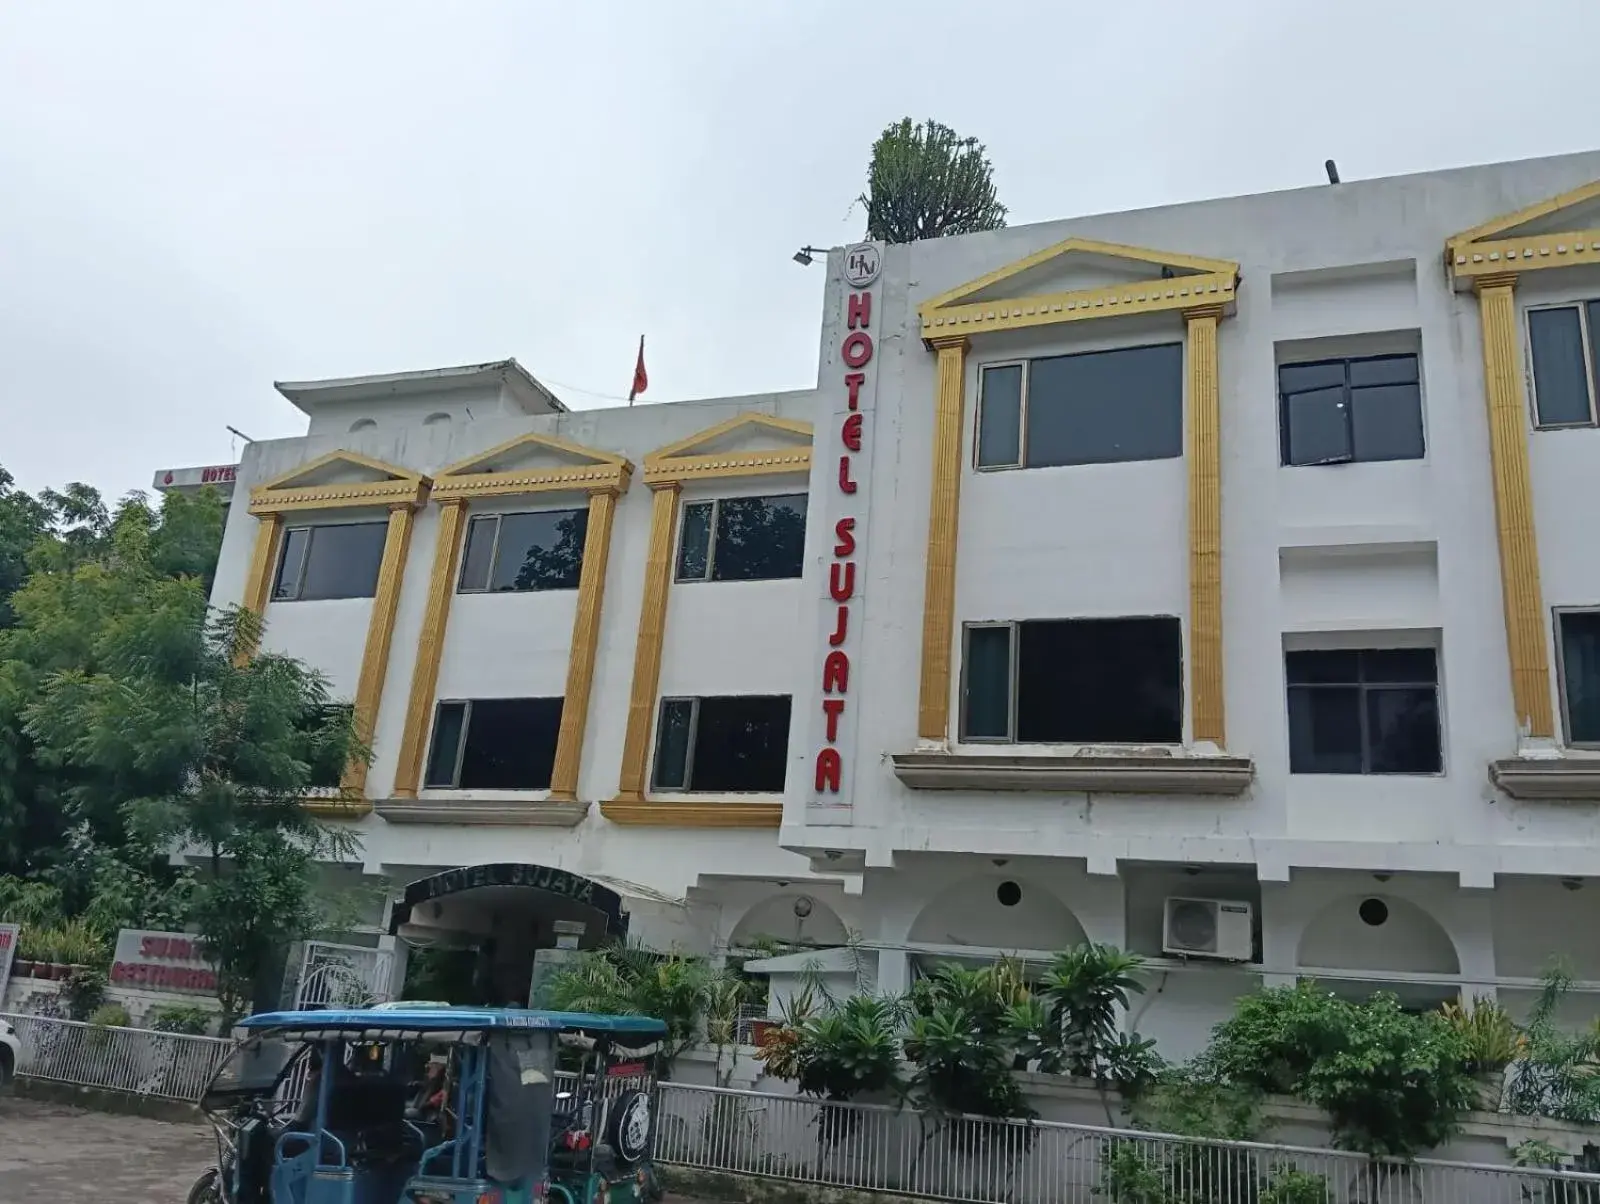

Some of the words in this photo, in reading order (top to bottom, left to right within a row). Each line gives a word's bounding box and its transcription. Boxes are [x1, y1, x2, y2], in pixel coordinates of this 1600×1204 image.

[839, 292, 874, 495] HOTEL
[815, 517, 856, 793] SUJATA
[511, 865, 594, 904] SUJATA
